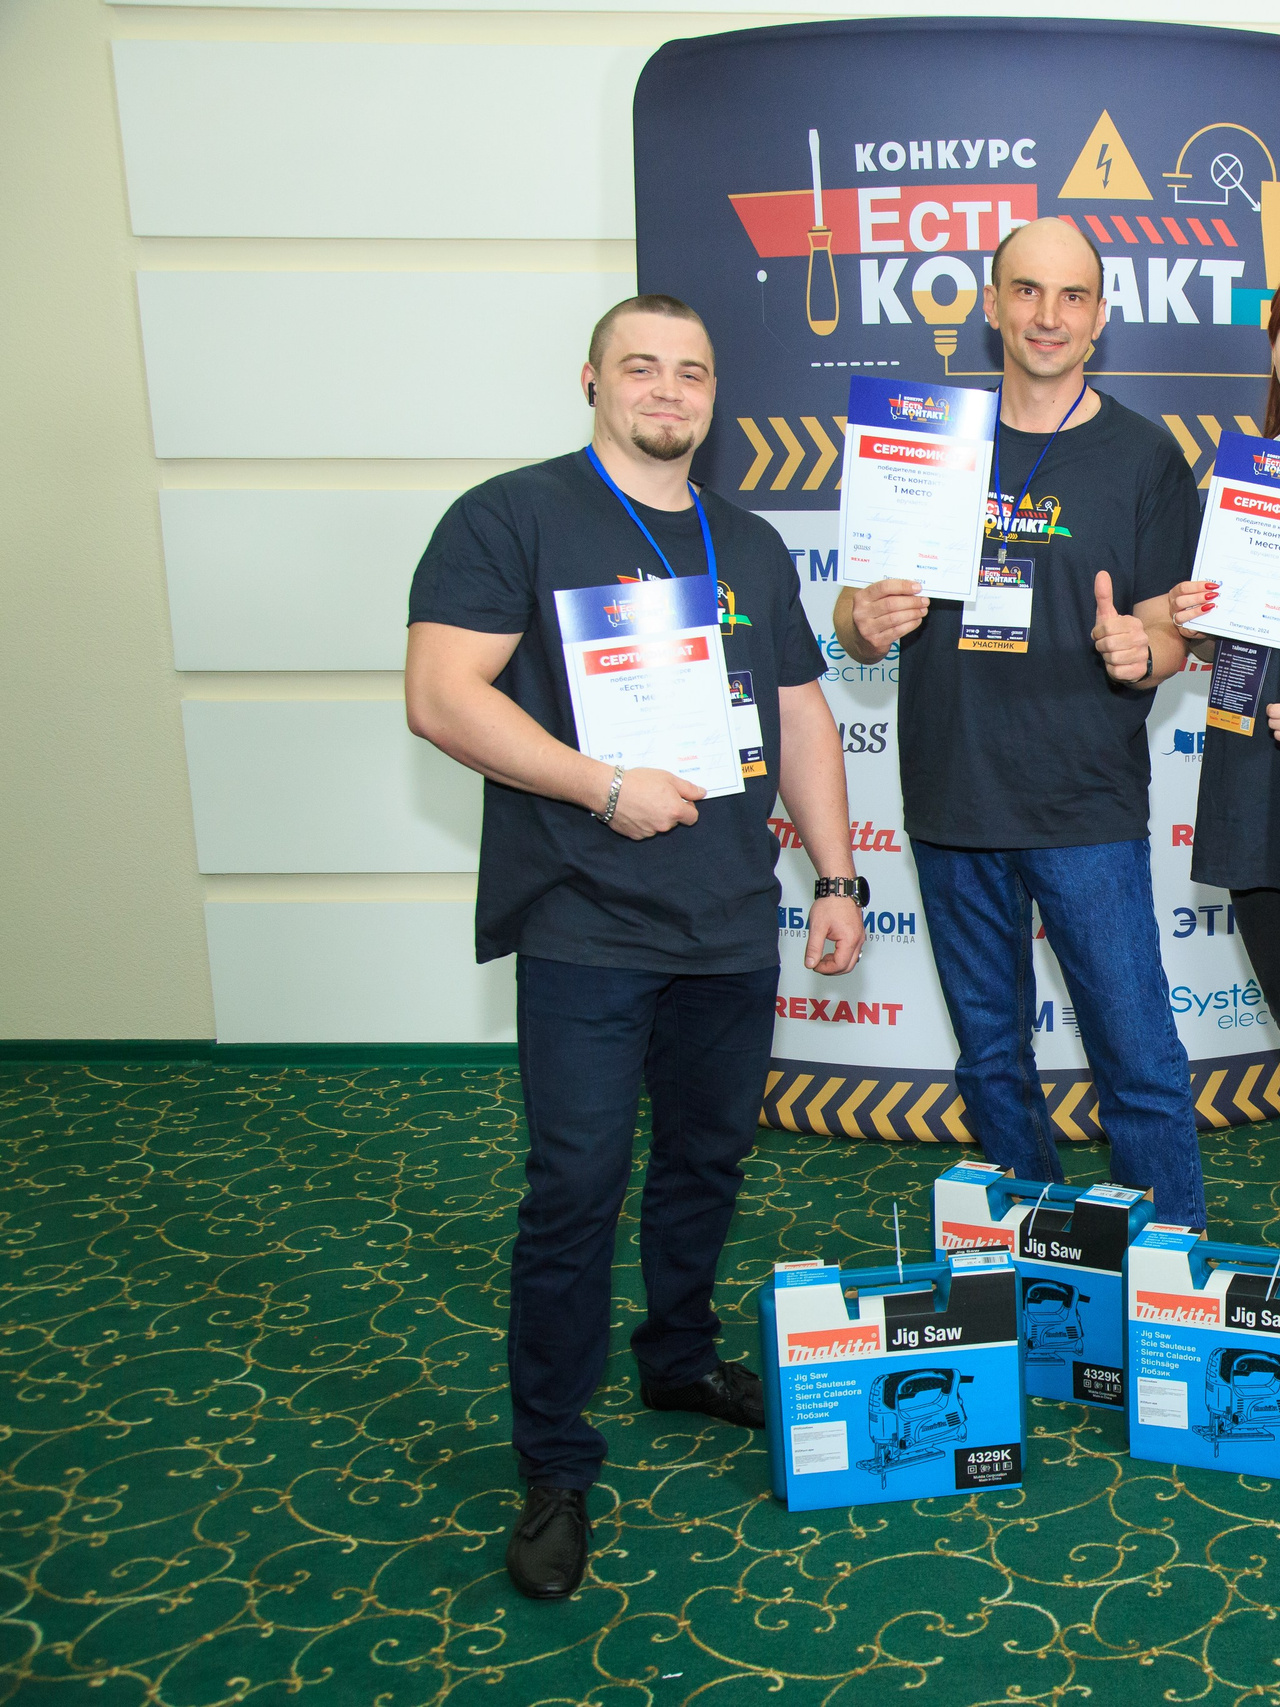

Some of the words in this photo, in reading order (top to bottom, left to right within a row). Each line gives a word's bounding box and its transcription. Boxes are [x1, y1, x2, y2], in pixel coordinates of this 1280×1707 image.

[855, 138, 1036, 172] КОНКУРС
[860, 255, 1245, 325] КОАКТ
[874, 444, 957, 461] СЕРТИФИК
[878, 465, 916, 473] победителя
[901, 488, 932, 497] место
[985, 514, 1048, 533] ОНТАКТ
[1236, 517, 1271, 527] победителя
[789, 549, 838, 581] ТМ
[972, 641, 1014, 649] УЧАСТНИК
[891, 935, 915, 943] ГОДА
[1171, 979, 1267, 1017] Systê
[775, 996, 903, 1025] REXANT
[1024, 1238, 1049, 1258] Jig
[1050, 1242, 1082, 1260] Saw
[1231, 1307, 1256, 1327] Jig
[892, 1328, 919, 1347] Jig
[924, 1325, 962, 1341] Saw
[1141, 1330, 1152, 1338] Jig
[1155, 1331, 1171, 1340] Saw
[1141, 1339, 1157, 1347] Scie
[1159, 1341, 1196, 1352] Sauteuse
[1141, 1349, 1164, 1357] Sierra
[1166, 1351, 1201, 1362] Caladora
[1141, 1358, 1179, 1369] Stichsäge
[794, 1373, 807, 1382] Jig
[810, 1372, 828, 1380] Saw
[1084, 1368, 1120, 1383] 4329K
[1141, 1367, 1170, 1377] Лобзик
[816, 1379, 856, 1389] Sauteuse
[795, 1392, 821, 1401] Sierra
[824, 1389, 862, 1399] Caladora
[796, 1400, 838, 1411] Stichsäge
[796, 1411, 829, 1420] Лобзик
[967, 1449, 1011, 1464] 4329K
